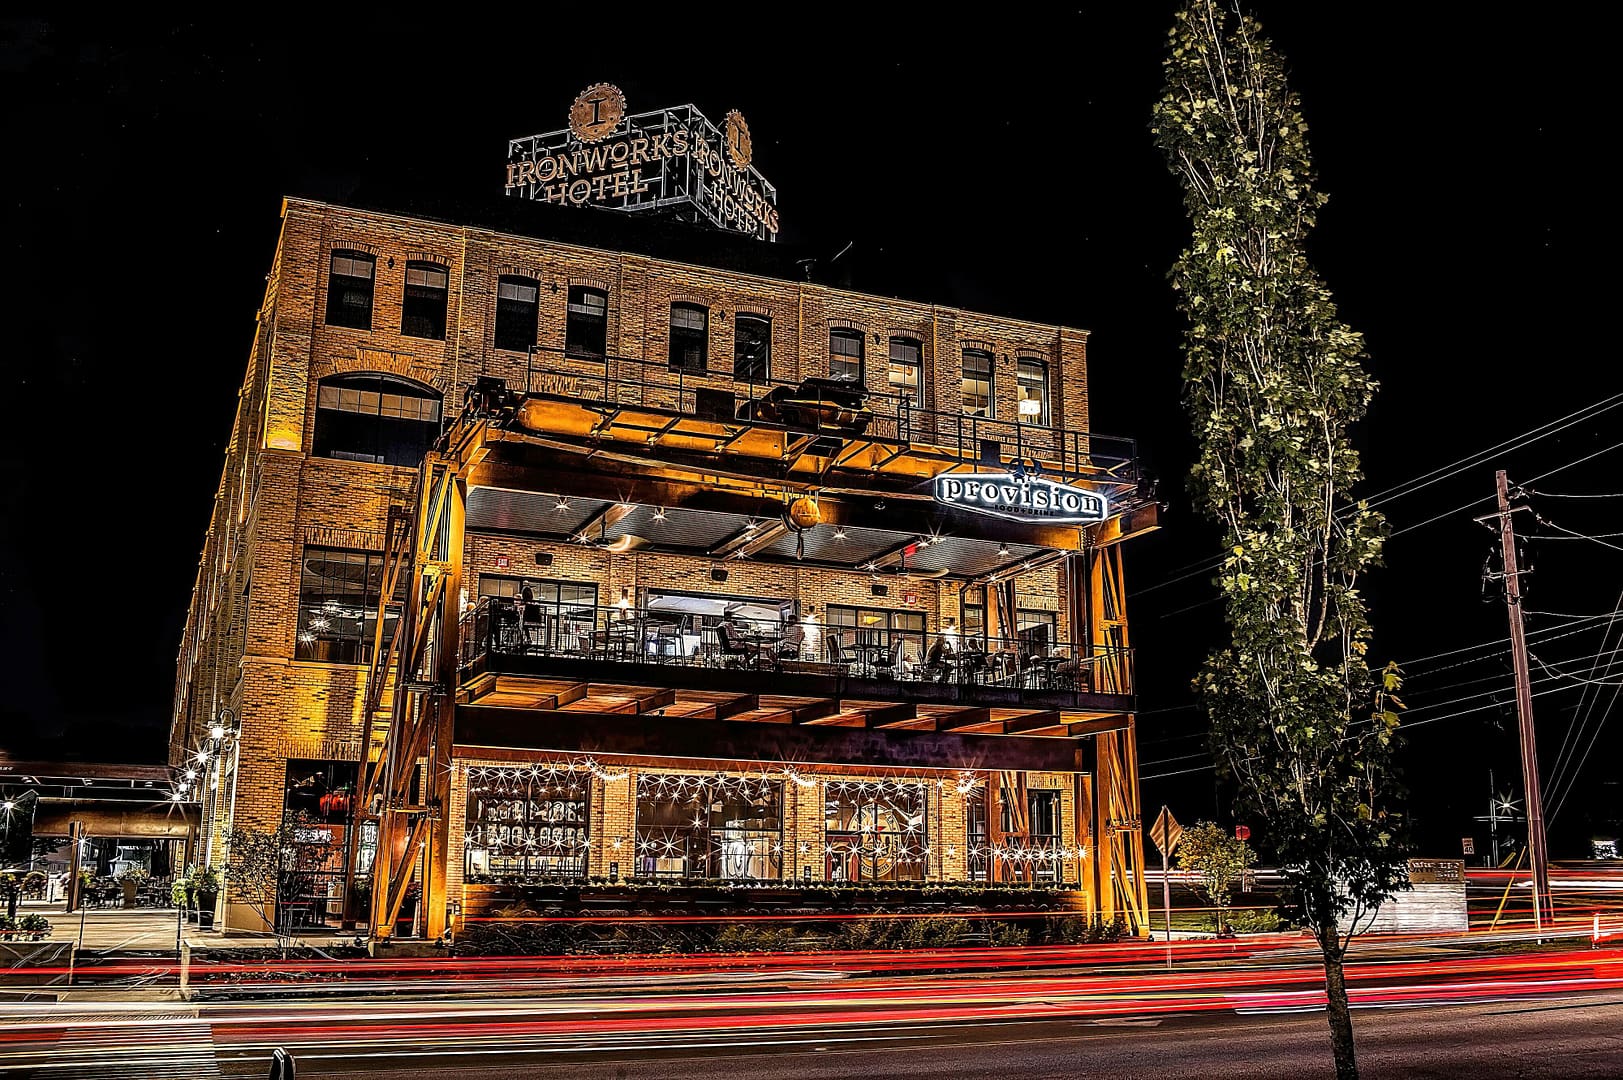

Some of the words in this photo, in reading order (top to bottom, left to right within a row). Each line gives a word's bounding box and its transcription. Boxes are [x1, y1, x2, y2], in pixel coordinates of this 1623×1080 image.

[587, 97, 607, 127] I
[505, 130, 688, 189] IRONWORKS
[546, 168, 649, 206] HOTEL
[945, 479, 1099, 512] provision
